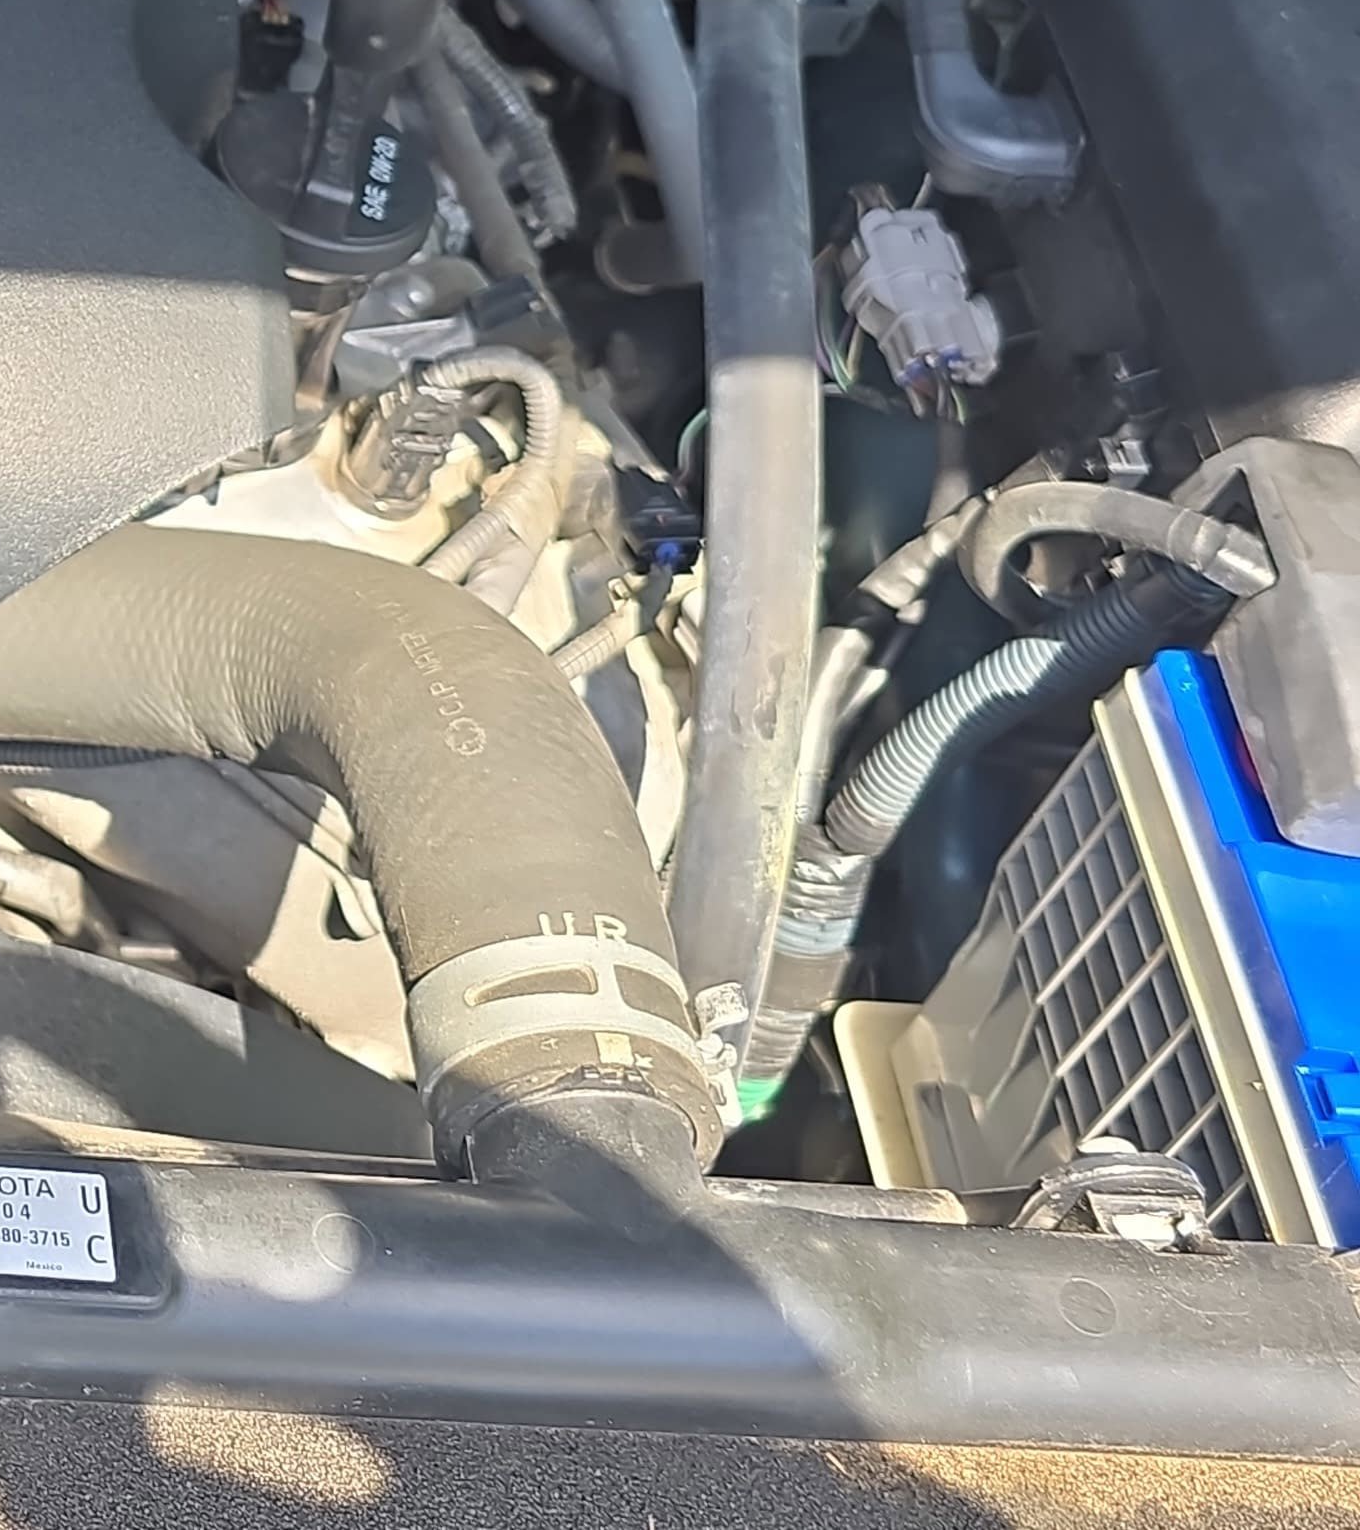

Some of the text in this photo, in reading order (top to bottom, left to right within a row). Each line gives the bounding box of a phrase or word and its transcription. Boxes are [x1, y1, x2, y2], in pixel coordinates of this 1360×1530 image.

[360, 183, 389, 221] SAE
[80, 1185, 102, 1215] U
[86, 1234, 109, 1264] C
